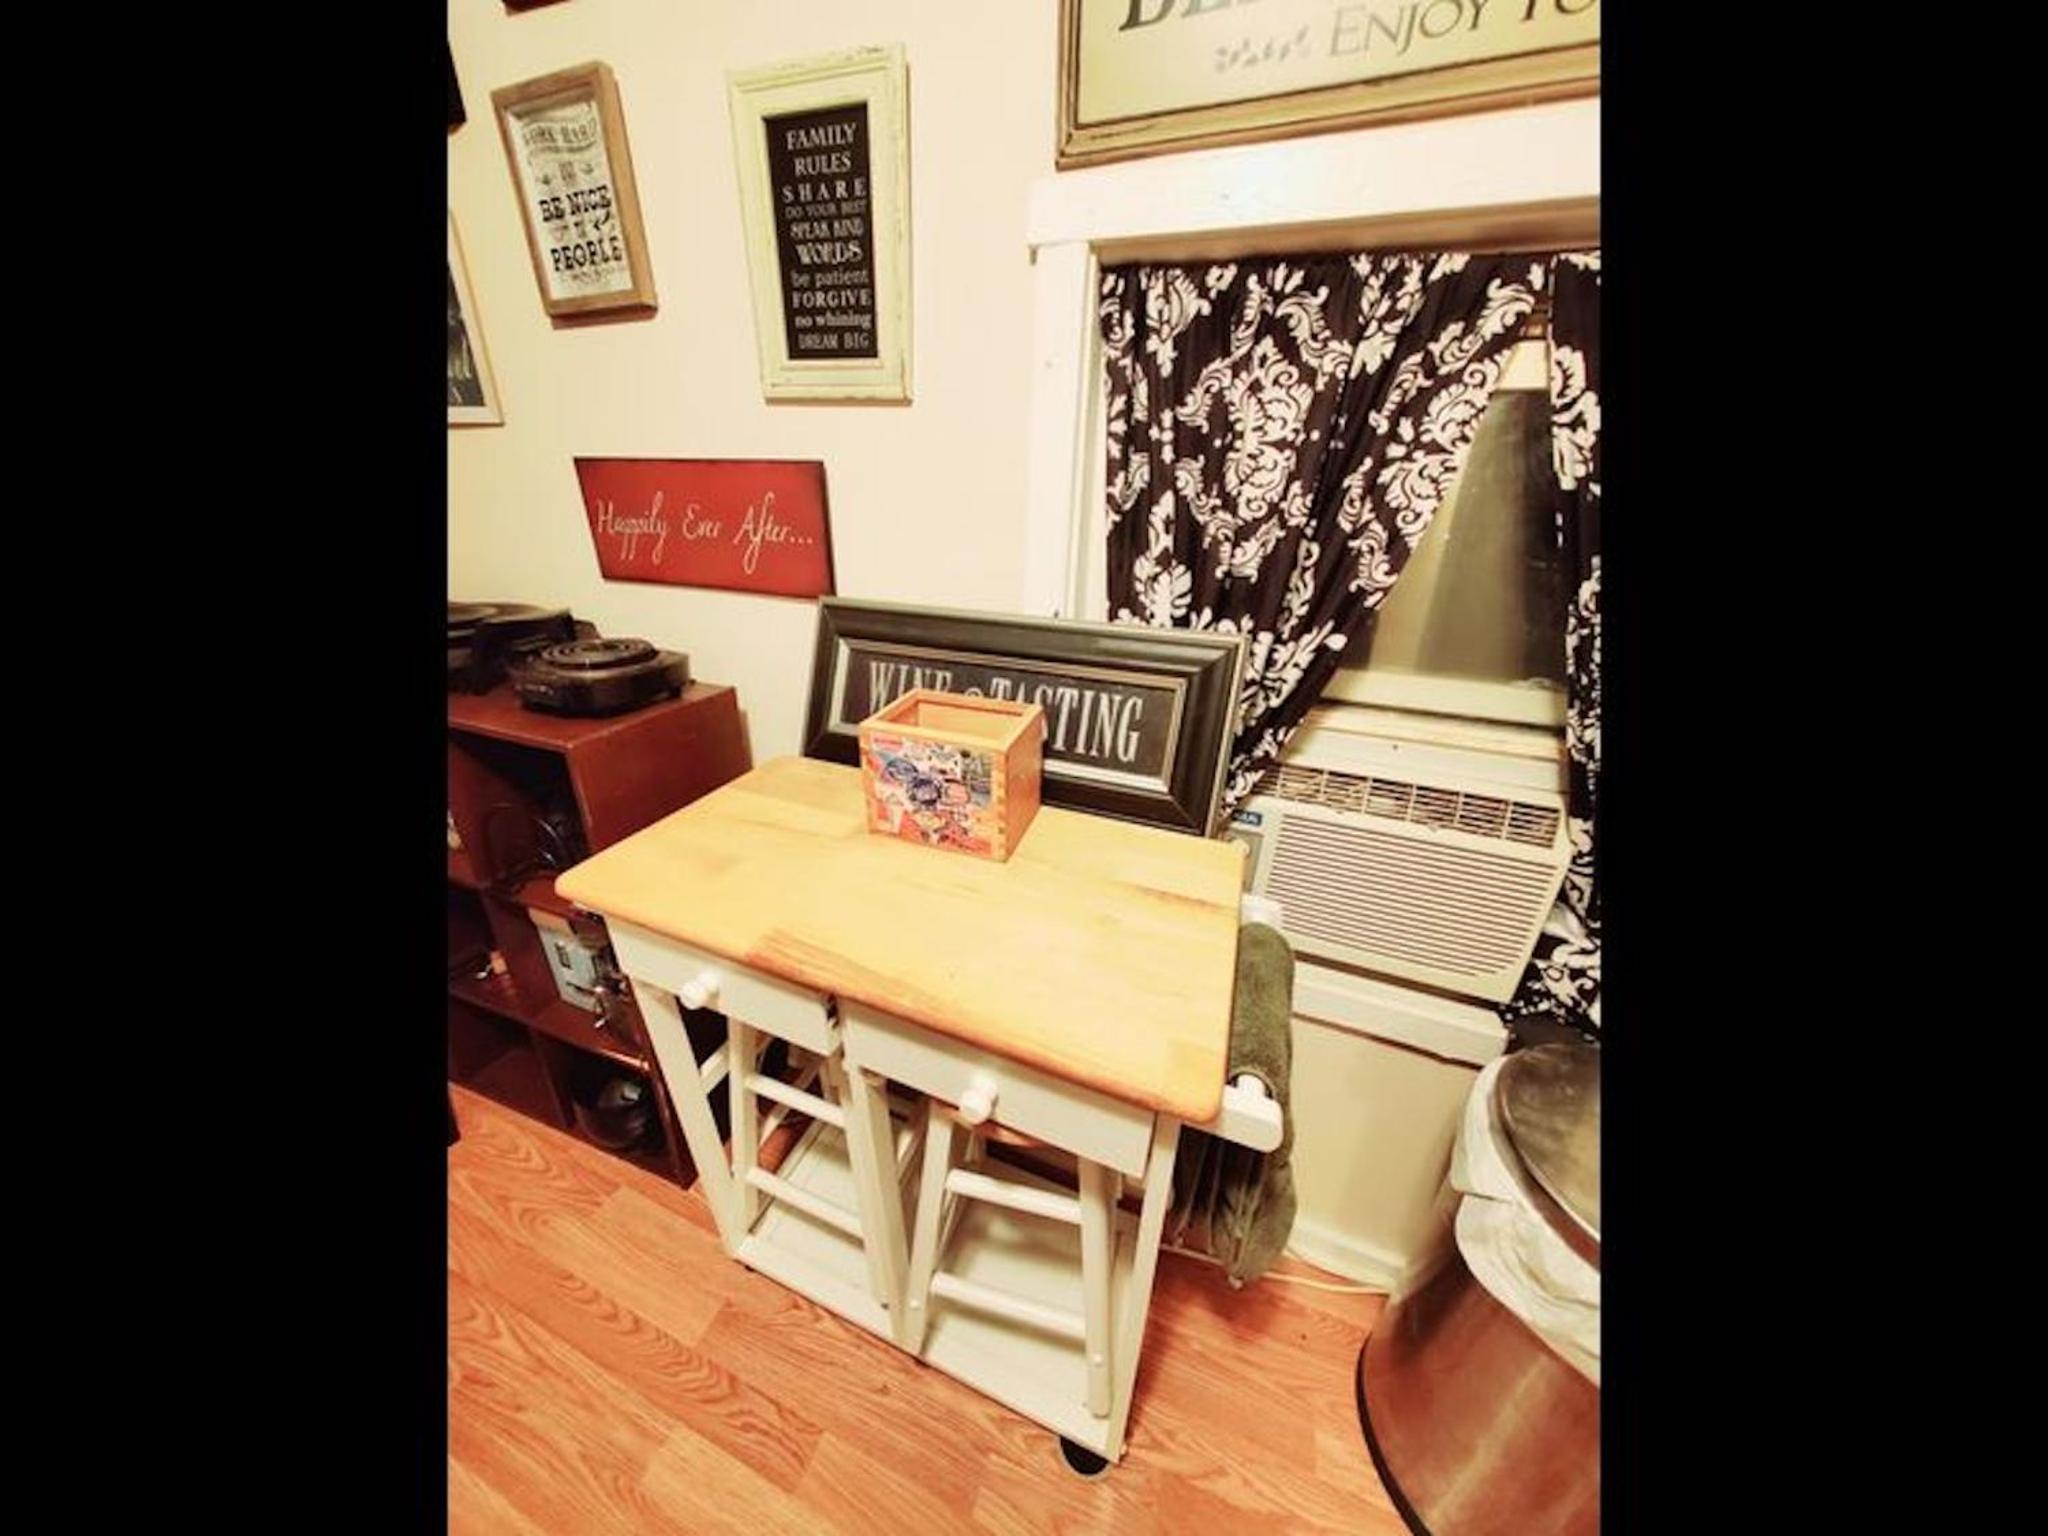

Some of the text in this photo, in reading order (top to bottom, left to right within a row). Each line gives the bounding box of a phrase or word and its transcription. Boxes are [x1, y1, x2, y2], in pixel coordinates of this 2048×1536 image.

[1329, 0, 1488, 56] ENJOY
[786, 122, 856, 150] FAMILY
[794, 151, 851, 176] RULES
[539, 185, 611, 222] BE NICE
[550, 236, 622, 272] PEOPLE
[795, 240, 863, 265] WORDS
[815, 265, 869, 289] patient
[792, 289, 872, 309] FORGIVE
[795, 311, 872, 330] no whining
[798, 332, 870, 350] DREAM BIG
[597, 490, 669, 566] Happily
[683, 504, 722, 541] Ever
